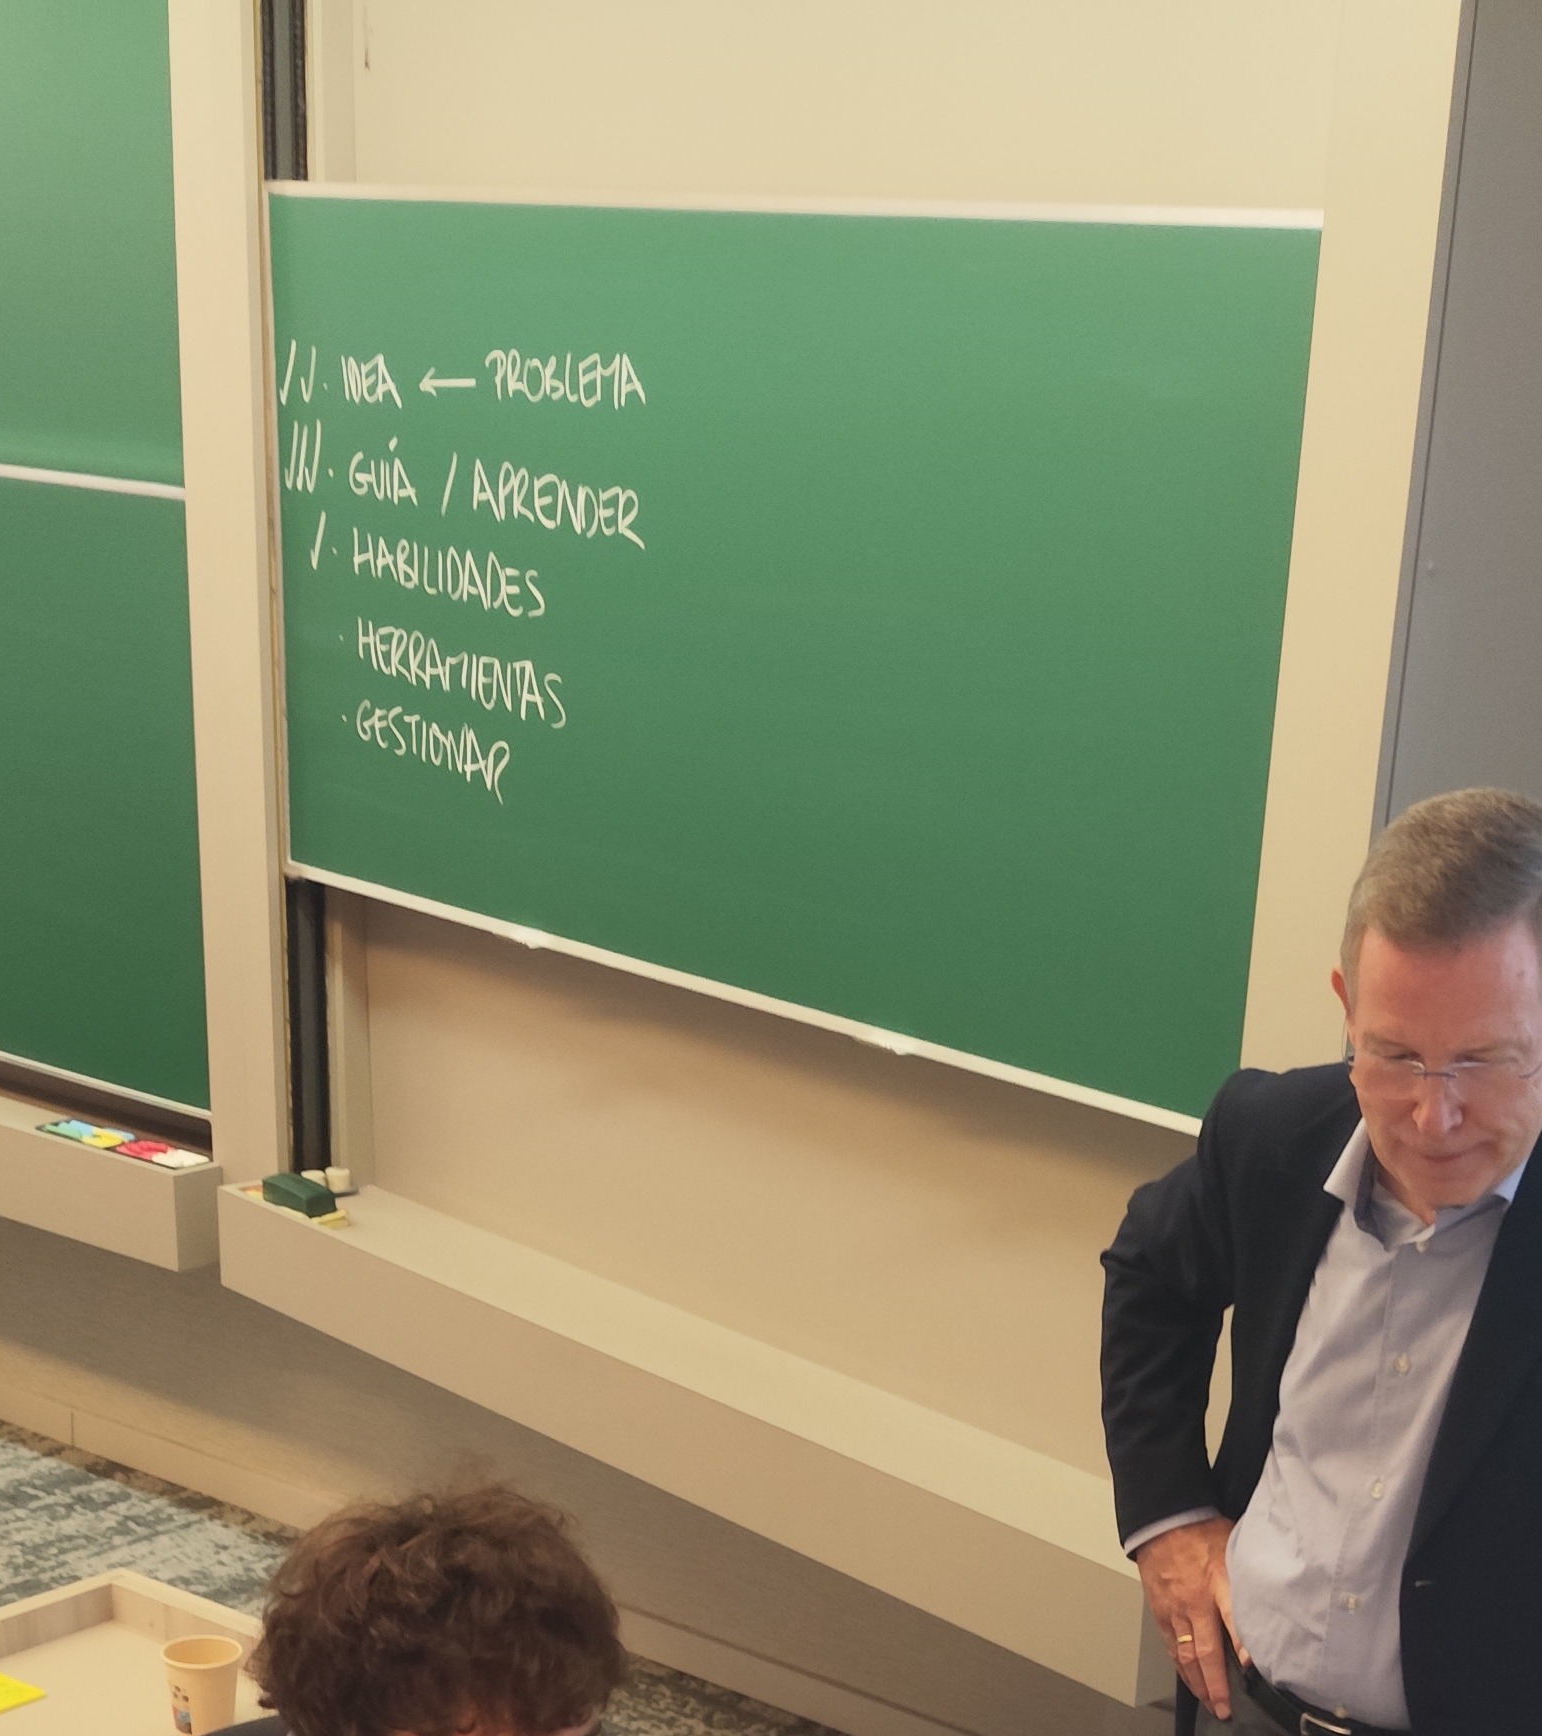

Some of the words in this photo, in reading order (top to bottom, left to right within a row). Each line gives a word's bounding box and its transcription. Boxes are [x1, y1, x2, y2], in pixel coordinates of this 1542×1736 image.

[341, 354, 402, 409] IDEA
[486, 349, 646, 410] PROBLEMA
[472, 458, 645, 550] APRENDER
[353, 527, 546, 617] HABILIDADES
[357, 616, 567, 729] HERRAMIENTAS
[355, 699, 510, 806] GESTIONAR
